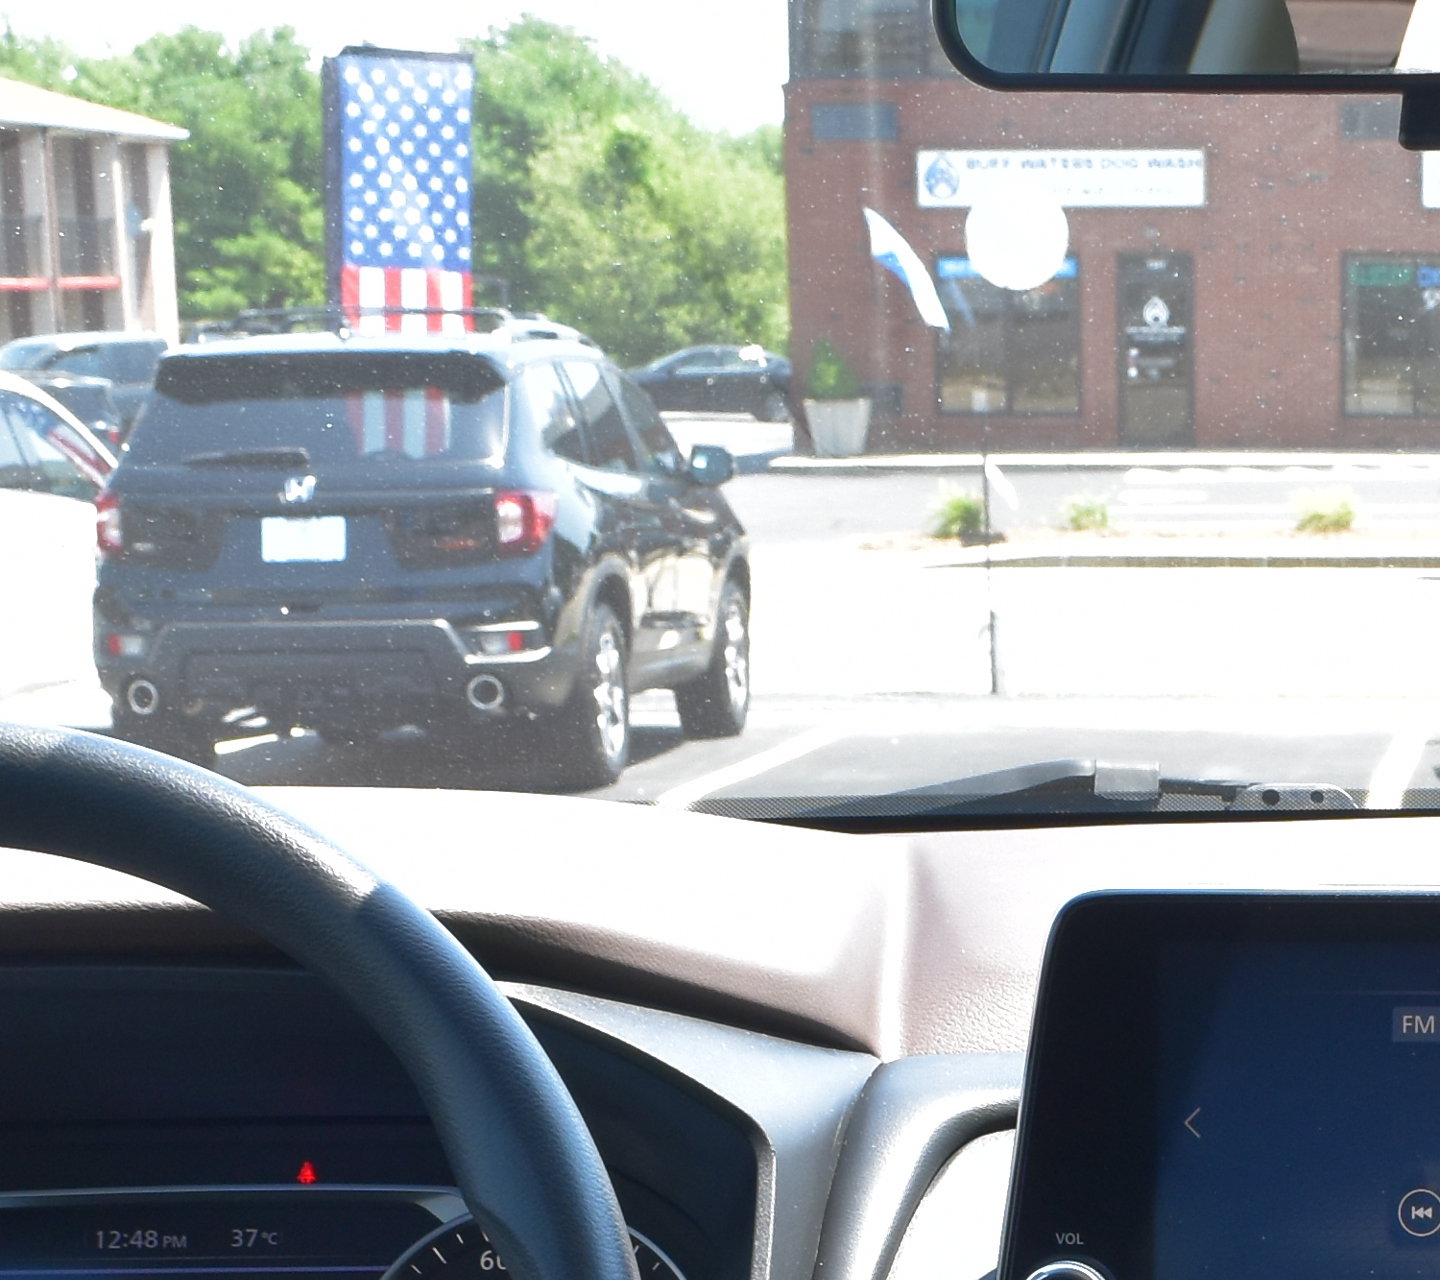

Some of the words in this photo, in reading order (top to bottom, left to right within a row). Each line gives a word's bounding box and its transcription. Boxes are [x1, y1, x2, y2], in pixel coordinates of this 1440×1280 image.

[1402, 1014, 1435, 1036] FM
[95, 1230, 158, 1250] 12:48
[1055, 1231, 1084, 1246] VOL
